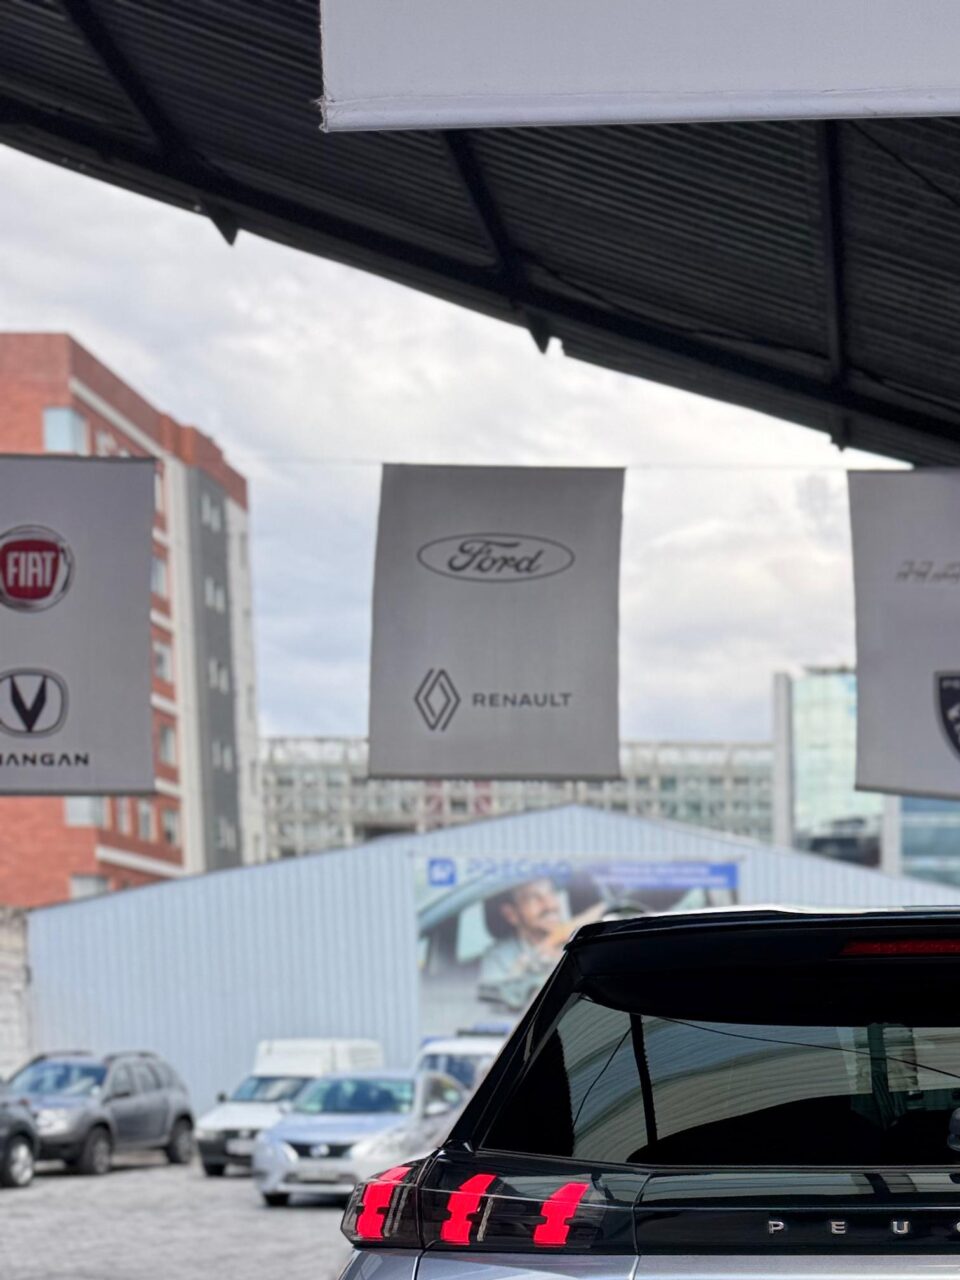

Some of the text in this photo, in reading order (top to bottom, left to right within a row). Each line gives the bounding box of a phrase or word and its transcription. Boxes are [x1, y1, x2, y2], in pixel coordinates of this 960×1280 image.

[448, 539, 544, 573] Ford
[7, 552, 56, 587] FIAT
[472, 693, 572, 707] RENAULT
[0, 752, 89, 767] ANGAN
